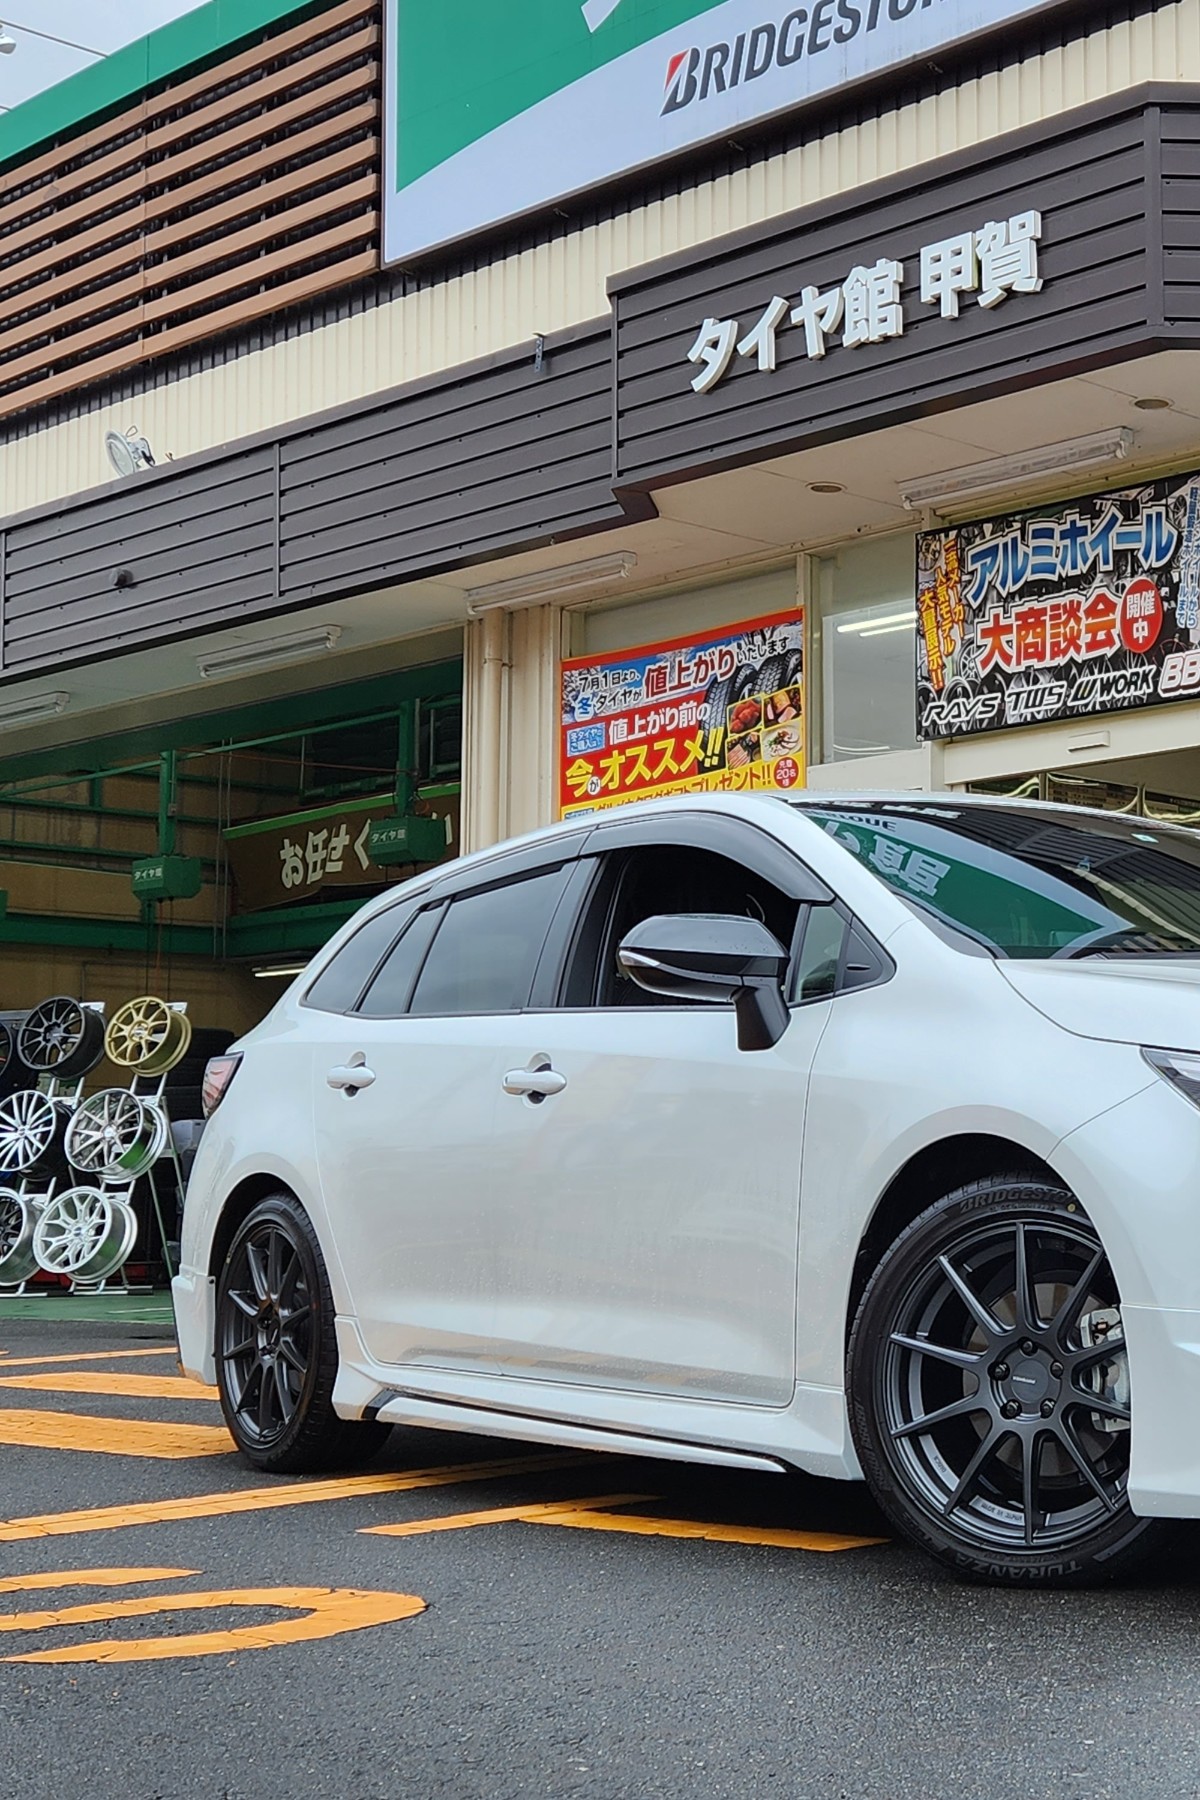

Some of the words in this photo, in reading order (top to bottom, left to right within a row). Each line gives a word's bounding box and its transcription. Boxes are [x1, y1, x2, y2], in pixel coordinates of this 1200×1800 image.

[660, 0, 946, 117] BRIDGEST
[687, 257, 904, 393] タイヤ館
[919, 209, 1044, 319] 甲賀
[967, 507, 1177, 606] アルミホイール
[934, 565, 956, 657] 人気モデル
[977, 590, 1120, 674] 大商談会
[1126, 589, 1156, 620] 開催
[1132, 618, 1149, 645] 中
[644, 647, 736, 698] 値上がり
[736, 635, 790, 665] いたします
[923, 695, 1000, 725] RAYS
[1008, 681, 1067, 715] TWS
[1097, 665, 1155, 702] WORK
[608, 701, 710, 746] 値上がり前の
[960, 1187, 1074, 1214] BRIDGESTO
